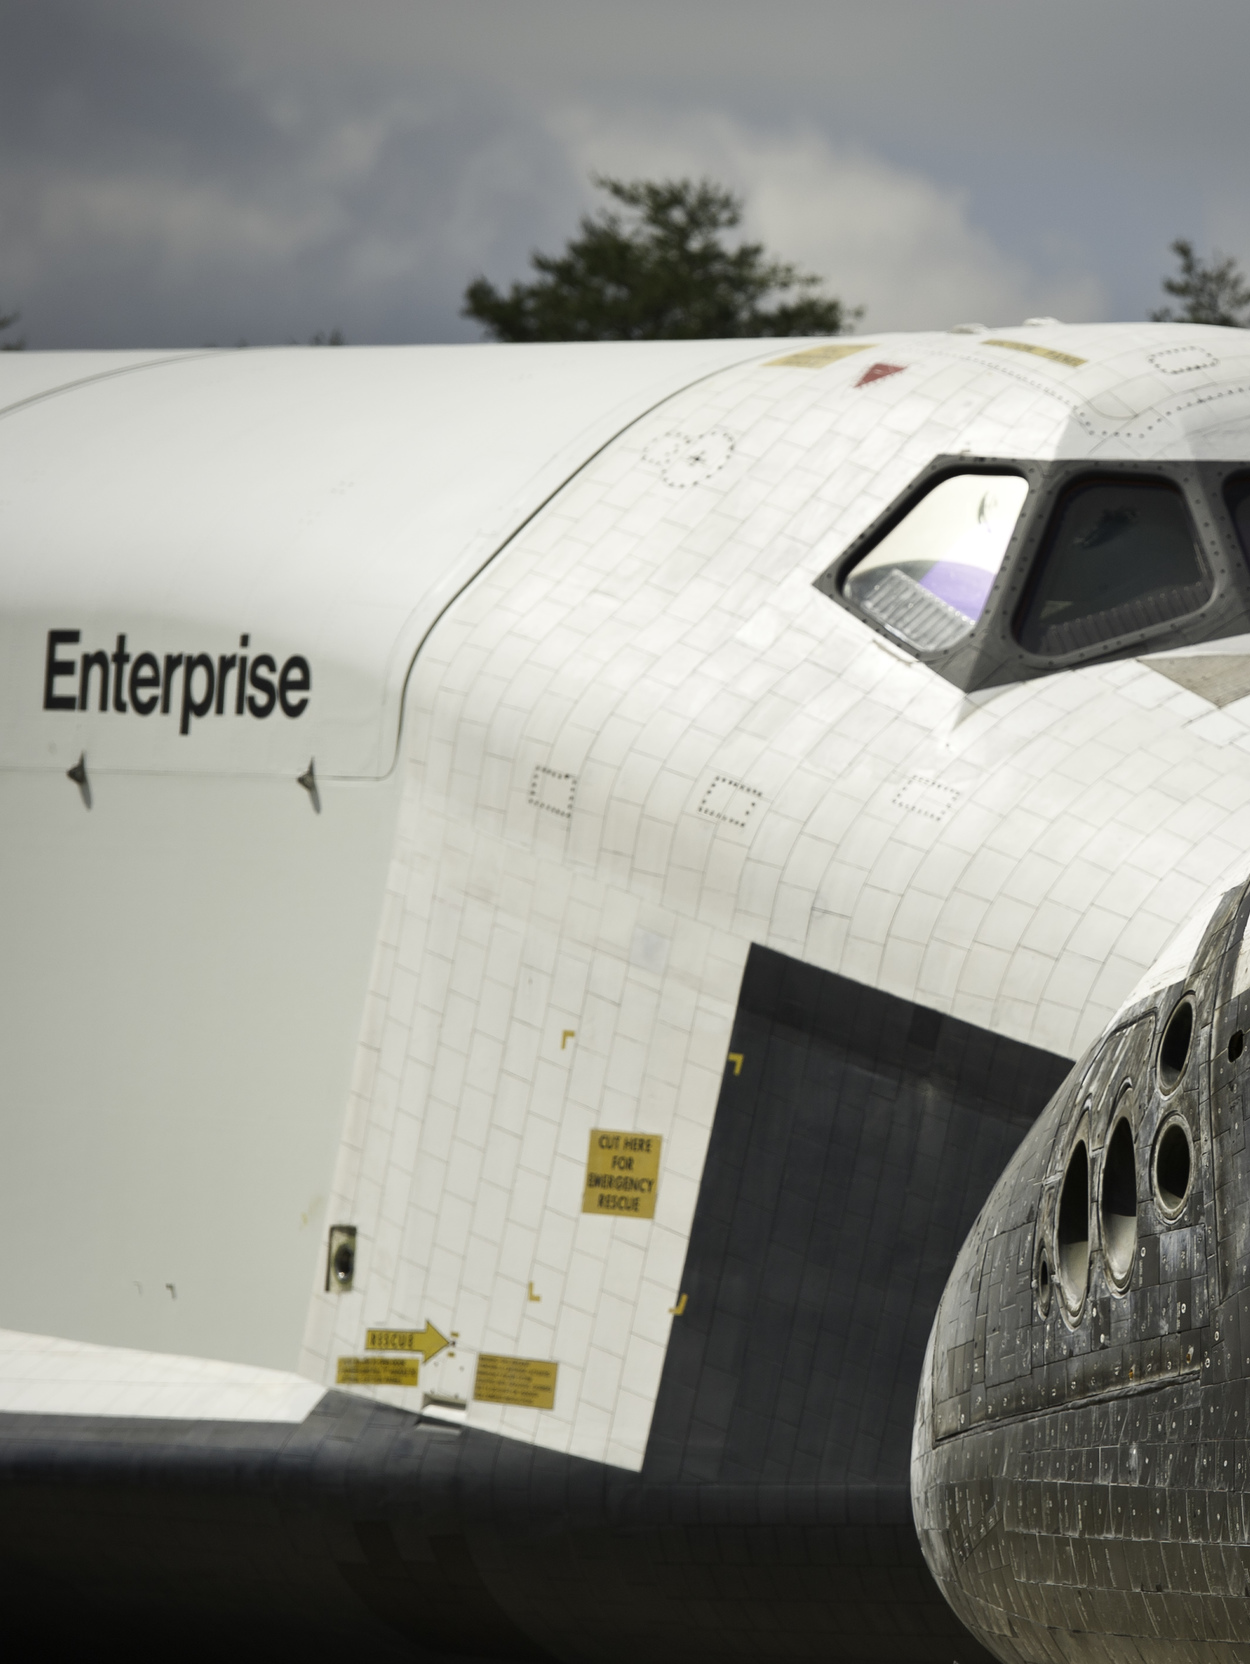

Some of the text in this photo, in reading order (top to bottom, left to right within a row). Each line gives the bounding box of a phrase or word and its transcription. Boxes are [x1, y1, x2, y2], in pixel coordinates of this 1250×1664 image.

[43, 629, 312, 736] Enterprise
[599, 1135, 652, 1152] CUT HERE
[612, 1155, 634, 1170] FOR
[588, 1173, 654, 1193] EMERGENCY
[598, 1194, 640, 1212] RESCUE
[370, 1333, 414, 1347] RESCUE
